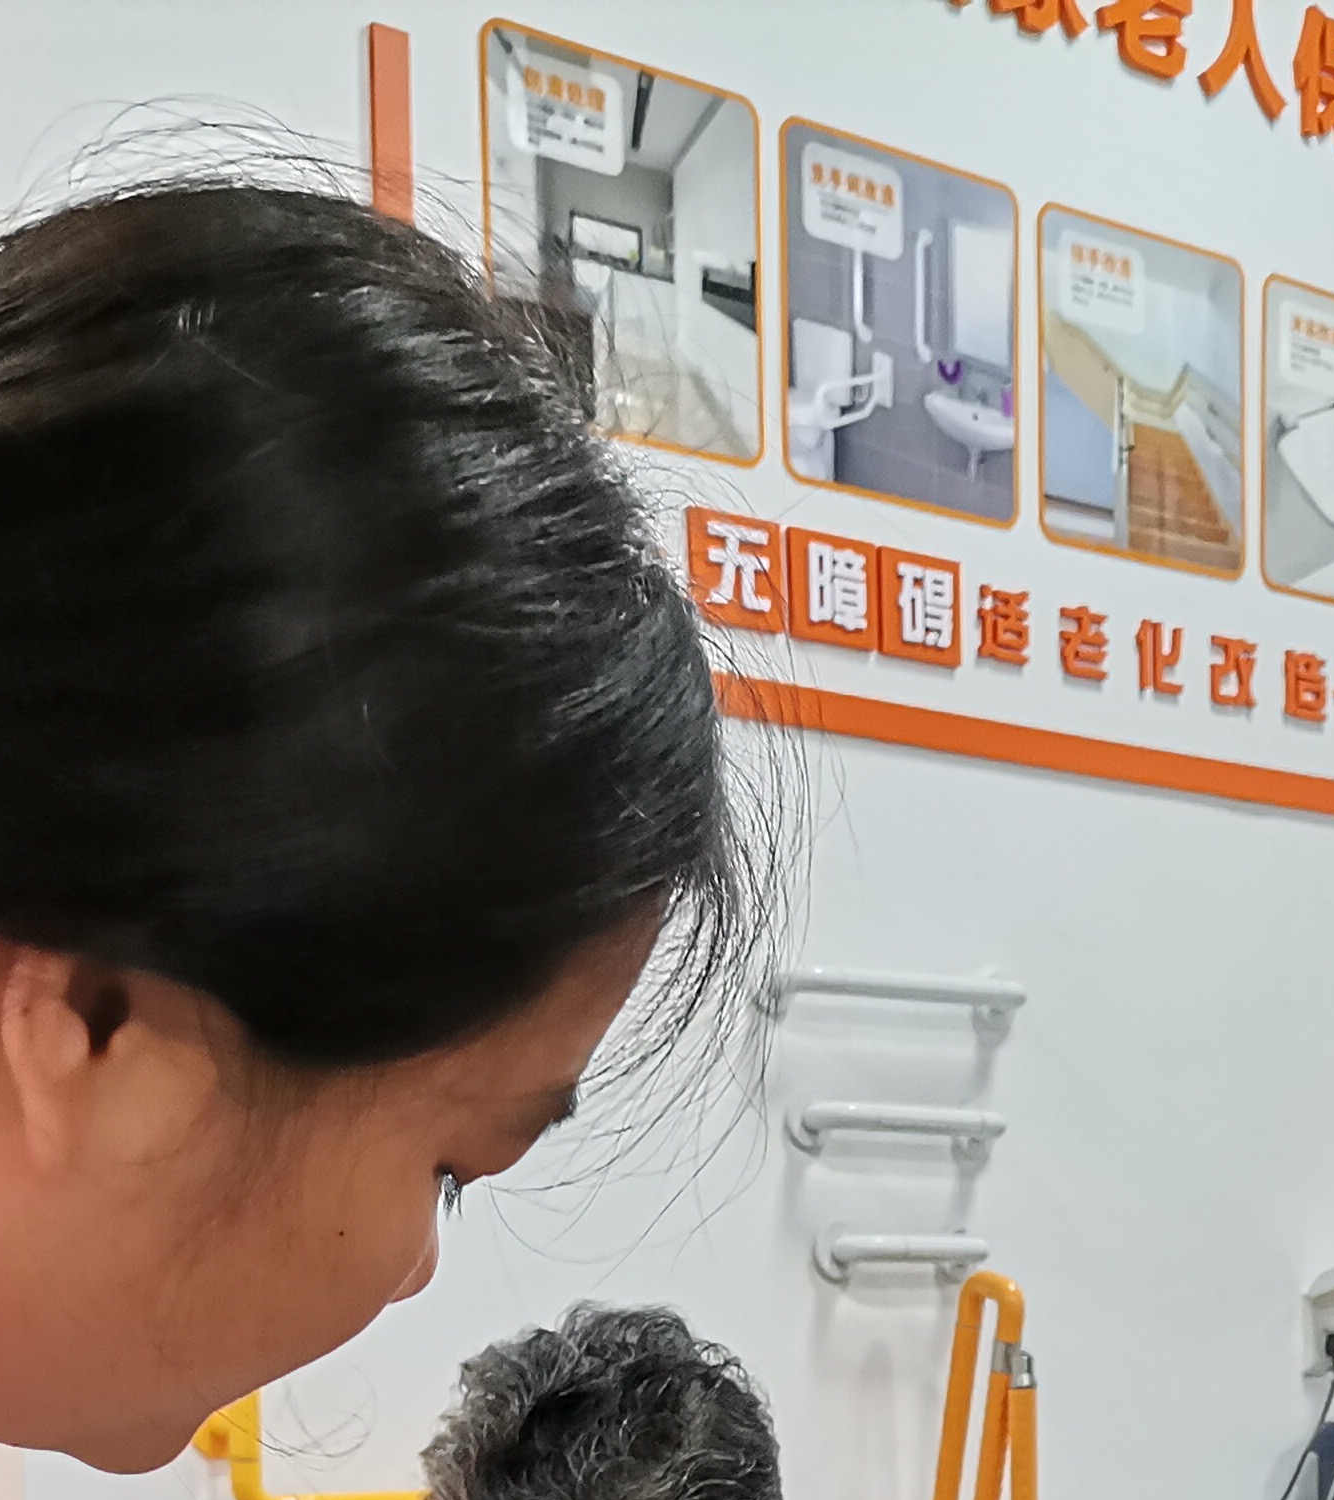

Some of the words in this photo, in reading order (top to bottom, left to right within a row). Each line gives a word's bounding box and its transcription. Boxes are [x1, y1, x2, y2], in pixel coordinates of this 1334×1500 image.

[707, 520, 1329, 723] 无障碍适老化改造
